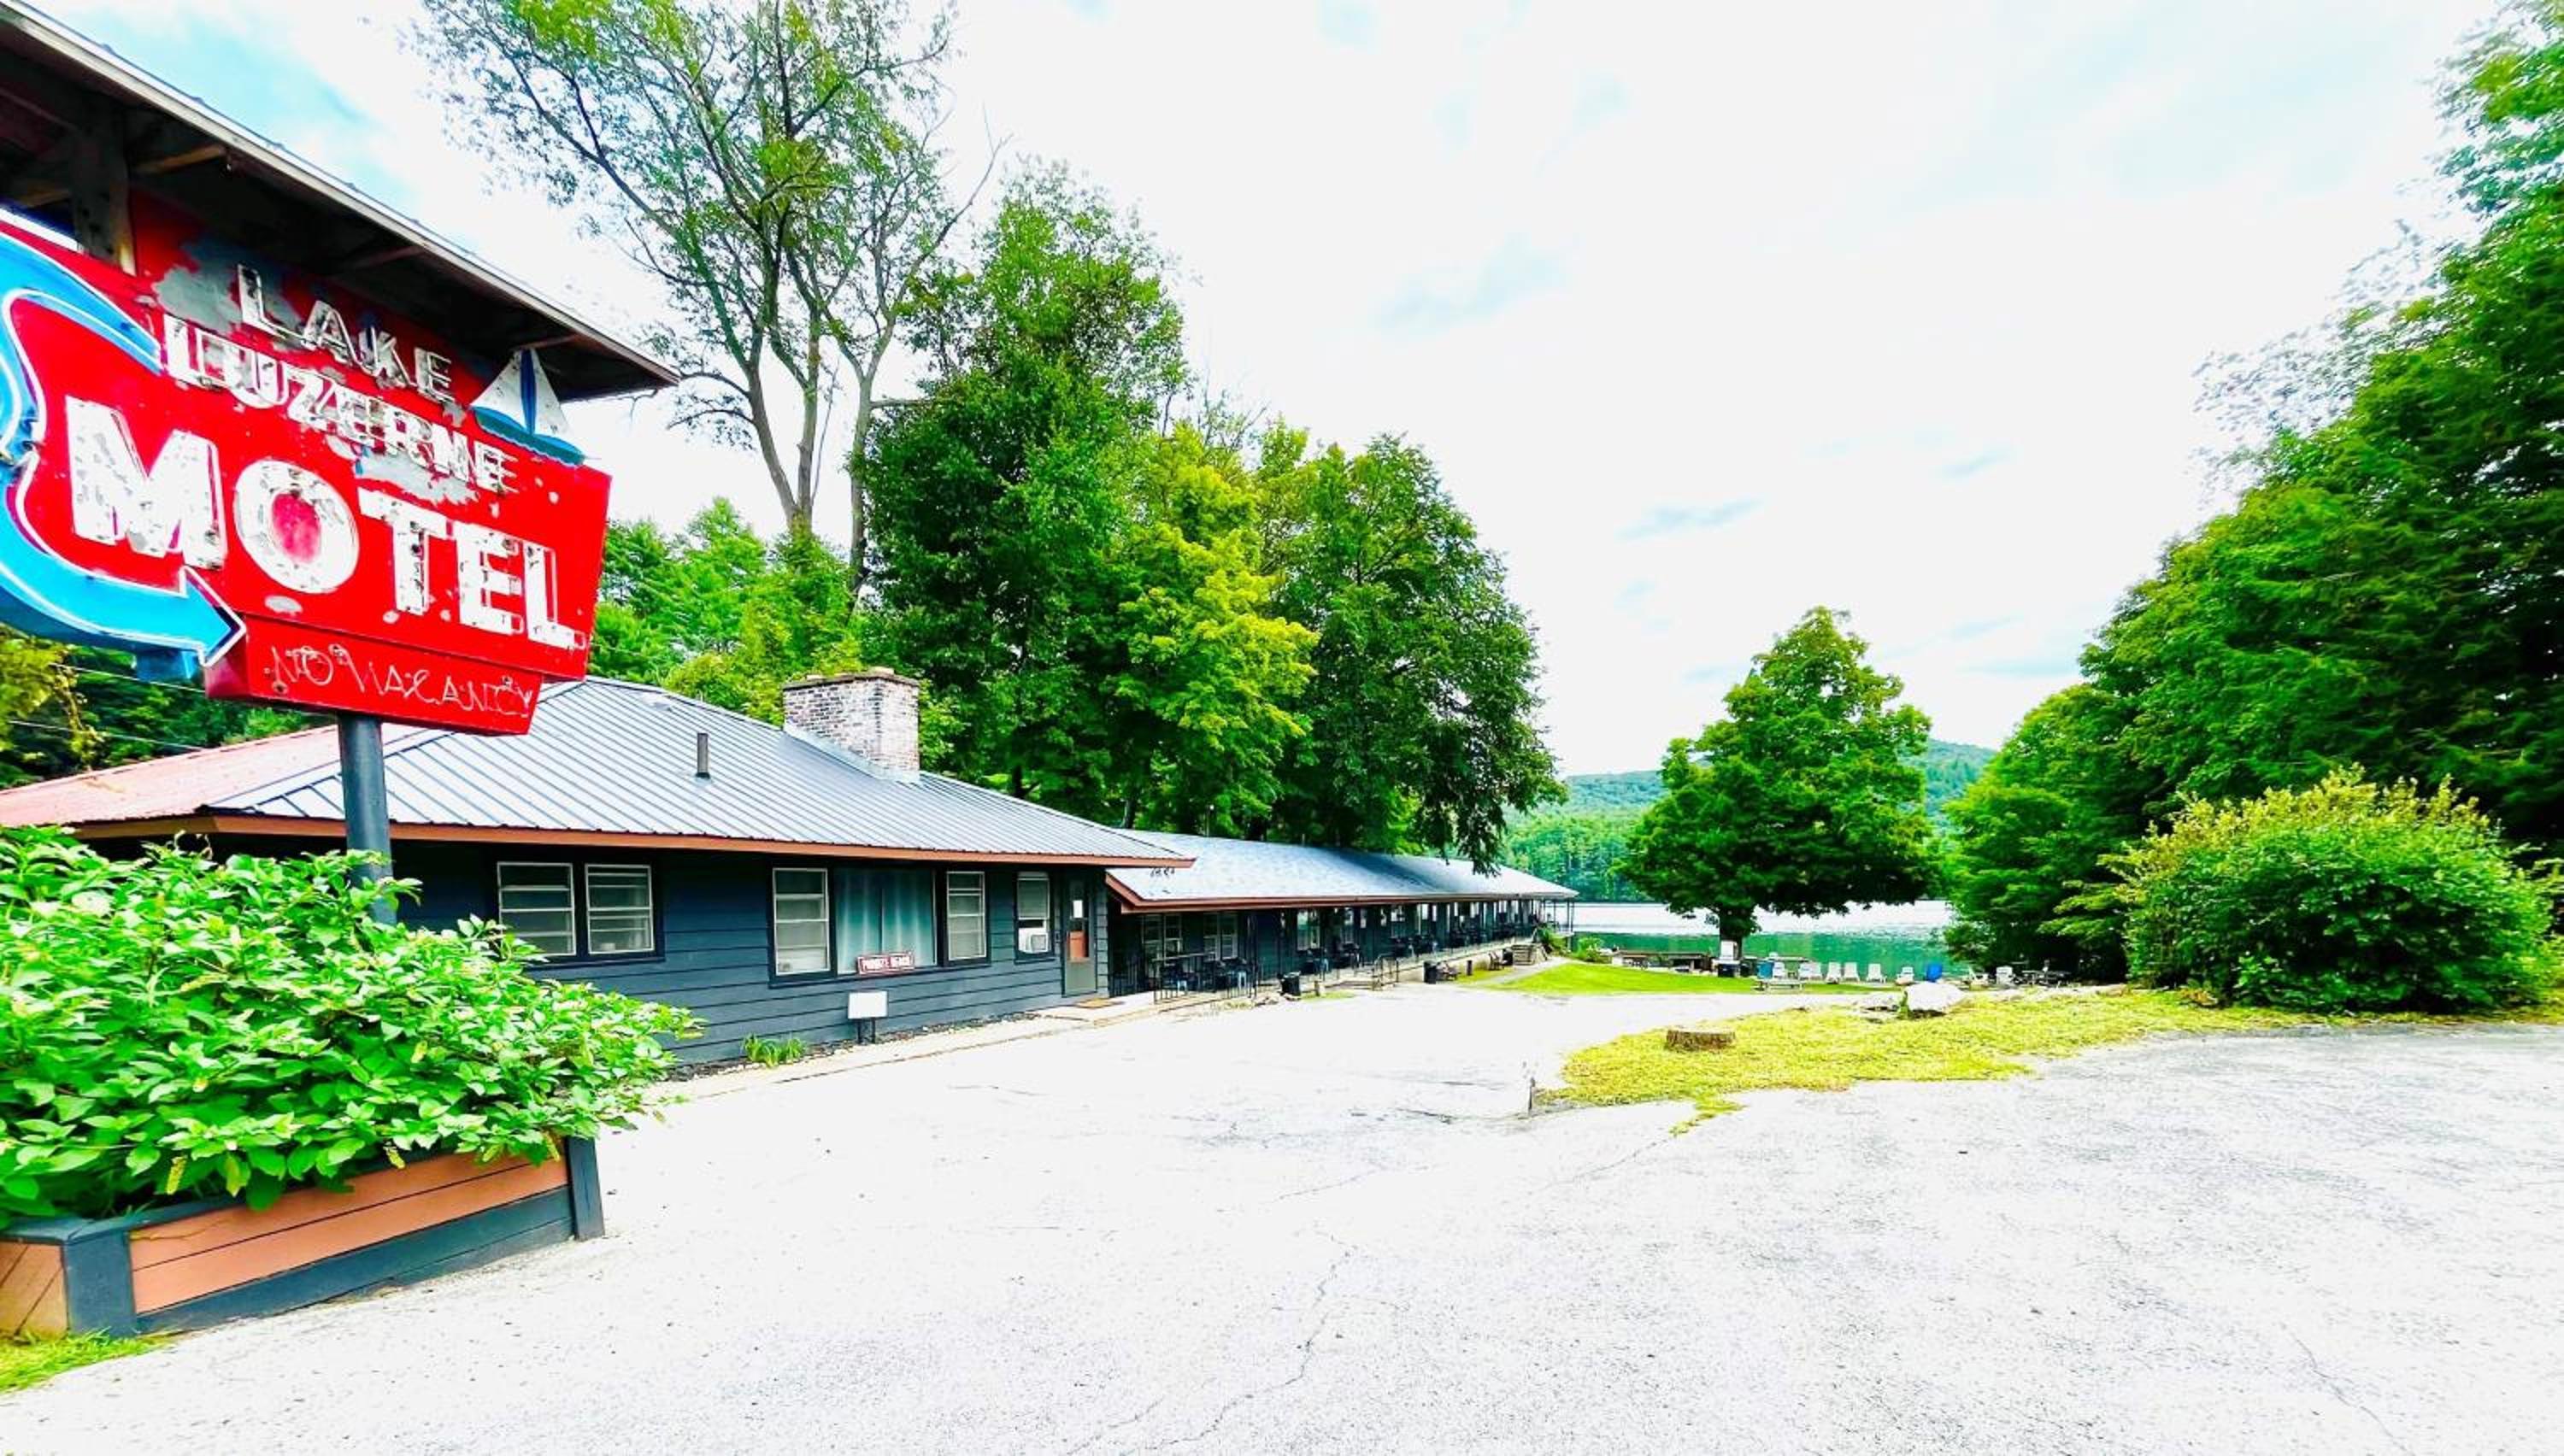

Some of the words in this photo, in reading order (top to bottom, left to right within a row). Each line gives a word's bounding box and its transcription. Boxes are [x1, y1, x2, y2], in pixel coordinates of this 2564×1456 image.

[163, 313, 520, 494] LUZERNE
[238, 264, 454, 404] LAKE
[65, 396, 587, 649] MOTEL
[268, 646, 334, 694] NO
[329, 645, 533, 718] VACANCY
